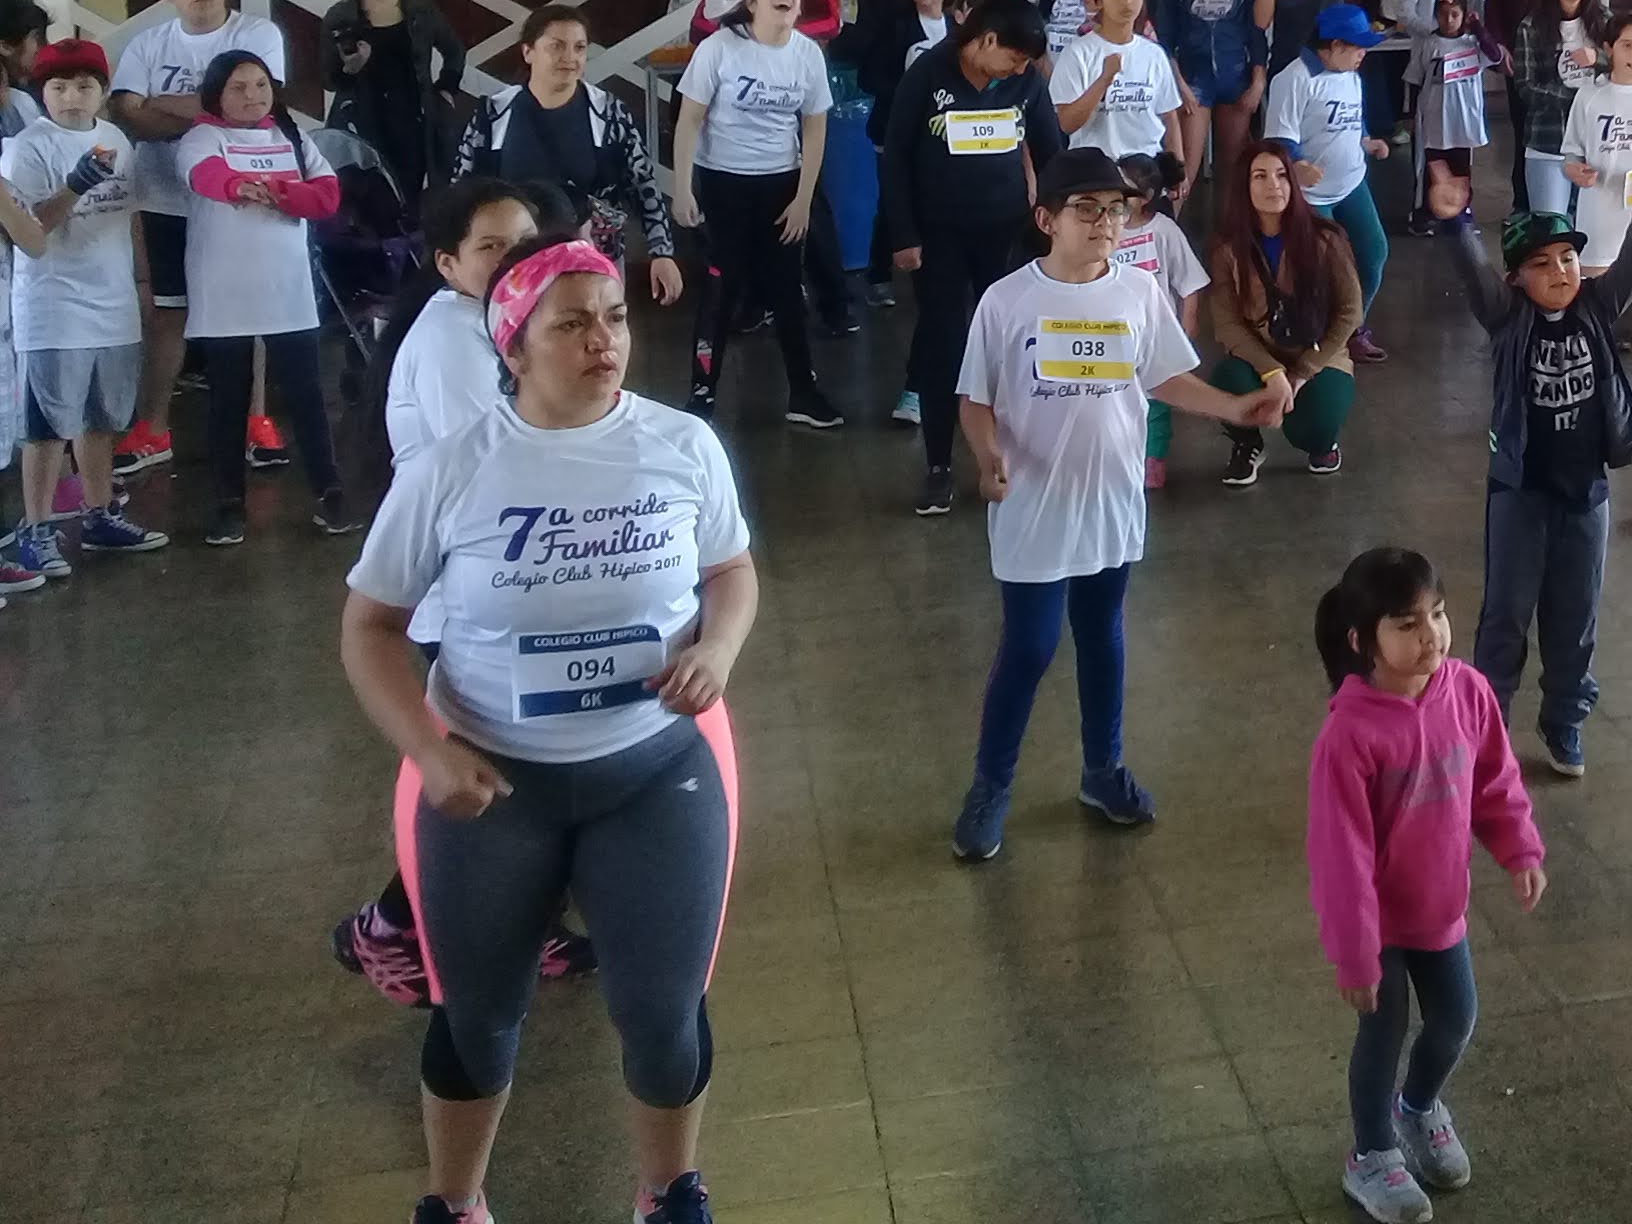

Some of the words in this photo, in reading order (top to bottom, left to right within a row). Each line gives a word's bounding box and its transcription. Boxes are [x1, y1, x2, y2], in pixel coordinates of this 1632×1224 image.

[972, 125, 995, 137] 109
[250, 158, 274, 170] 019
[1116, 250, 1137, 264] 027
[1072, 340, 1105, 357] 038
[1080, 365, 1096, 376] 2K
[1554, 406, 1580, 432] IT!
[582, 492, 668, 524] corrida
[533, 519, 674, 566] Familiar
[491, 569, 549, 594] Colegio
[552, 564, 593, 585] Club
[654, 554, 682, 571] 2017
[533, 634, 582, 648] COLEGIO
[583, 631, 611, 644] CLUB
[612, 626, 649, 641] HIPICO
[566, 655, 616, 682] 094
[580, 690, 603, 709] 6K
